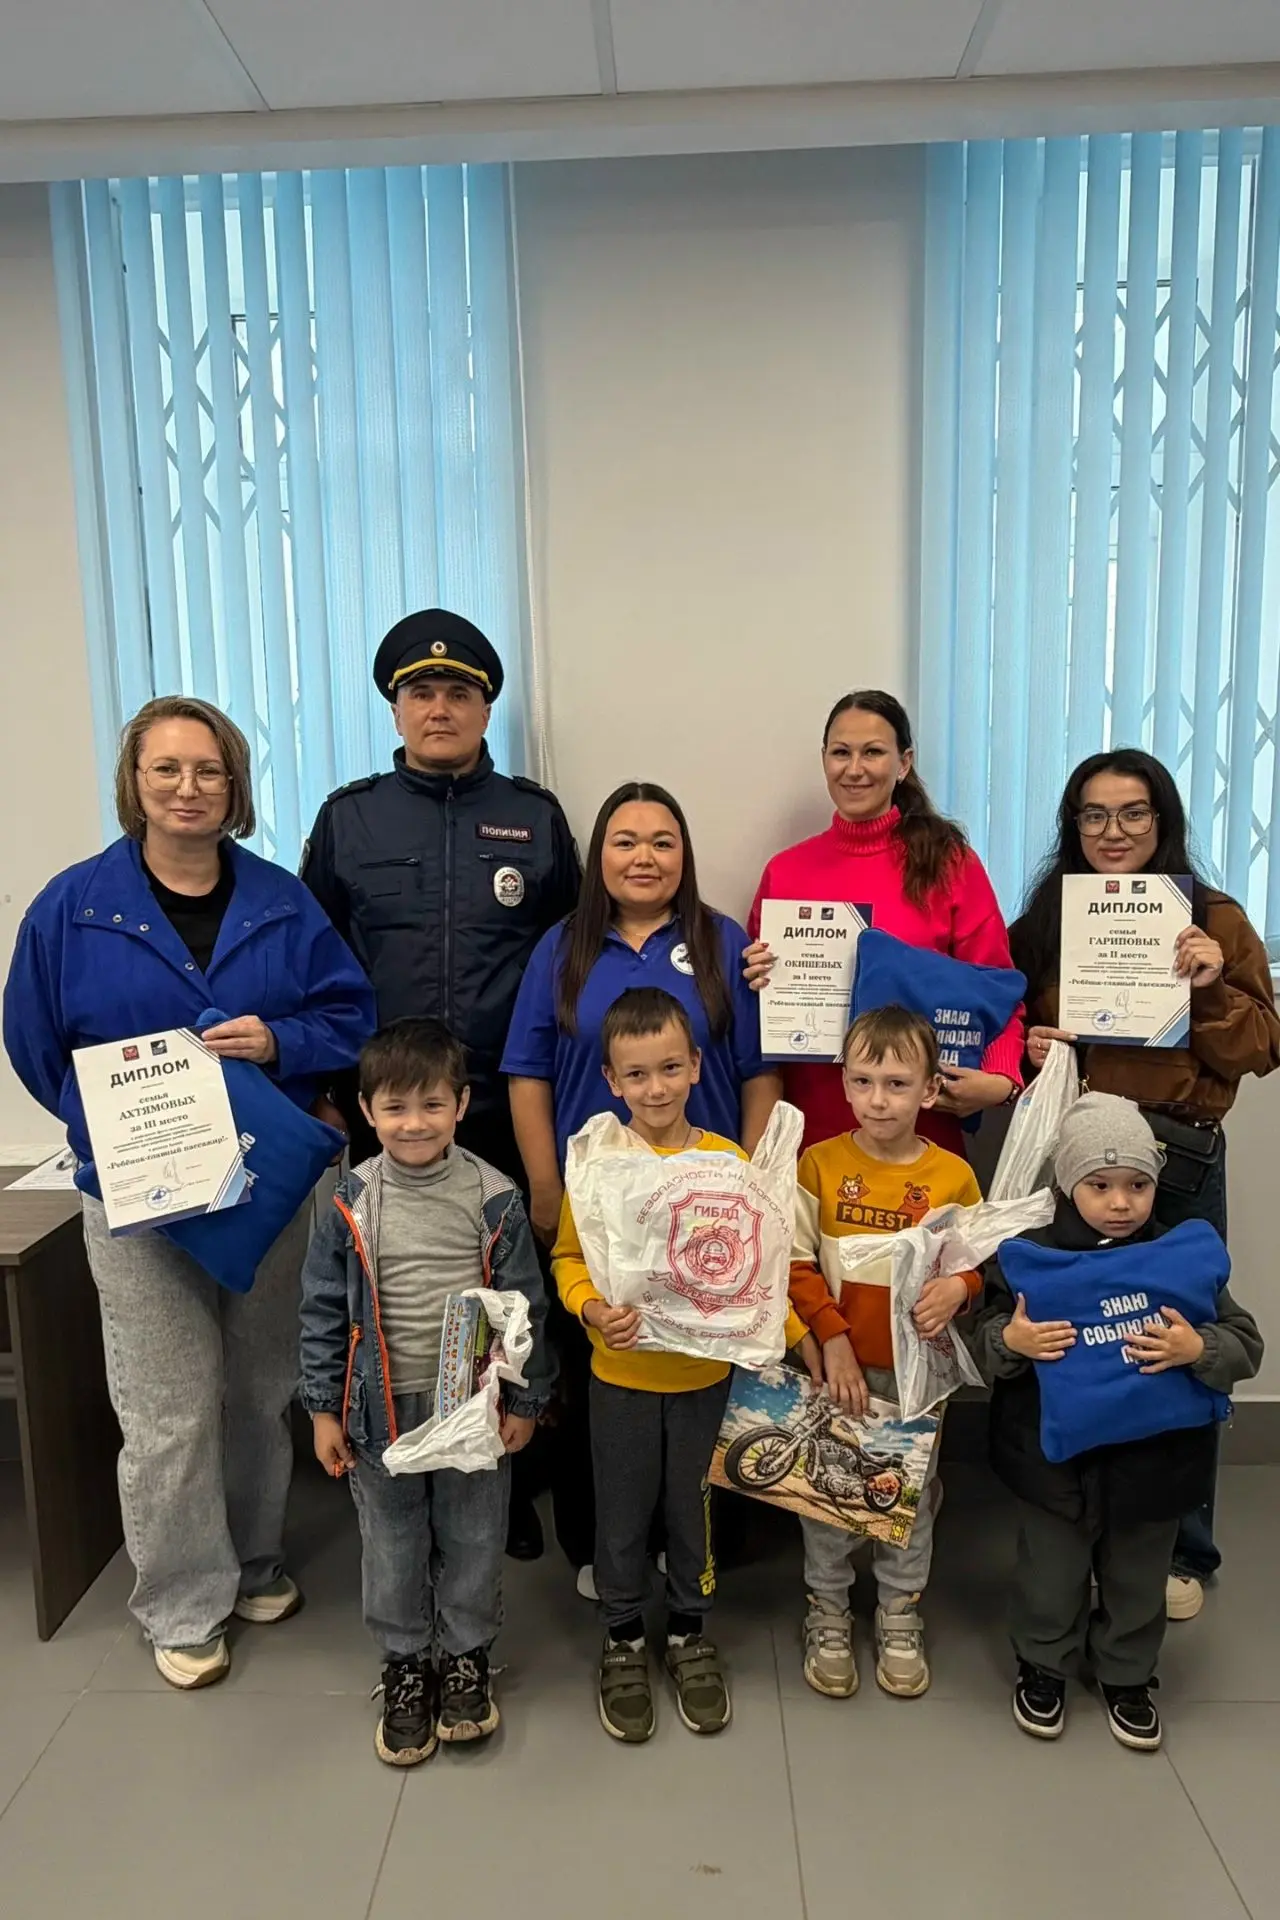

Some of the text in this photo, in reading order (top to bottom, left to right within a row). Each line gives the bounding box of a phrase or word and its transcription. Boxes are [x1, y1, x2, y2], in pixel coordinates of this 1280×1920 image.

[481, 825, 529, 838] ПОЛИЦИЯ
[1087, 902, 1163, 915] ДИПЛОМ
[783, 926, 847, 939] ДИПЛОМ
[1089, 937, 1161, 946] ГАРИПОВЫХ
[934, 1008, 970, 1026] ЗНАЮ
[936, 1030, 981, 1047] ЛЮДАЮ
[938, 1049, 959, 1067] ДД
[110, 1058, 190, 1088] ДИПЛОМ
[119, 1095, 197, 1121] АХТЯМОВЫХ
[144, 1120, 157, 1130] III
[159, 1114, 188, 1126] место
[636, 1169, 723, 1225] БЕЗОПАСНОСТЬ
[748, 1181, 790, 1235] ДОРОГАХ
[694, 1205, 740, 1221] ГИБДД
[842, 1205, 908, 1229] FOREST
[1100, 1292, 1149, 1318] ЗНАЮ
[1082, 1312, 1168, 1346] СОБЛЮА
[443, 1302, 456, 1419] ОГОРАЗОВЫЕ
[450, 1321, 460, 1411] АКЛЕЙКИ
